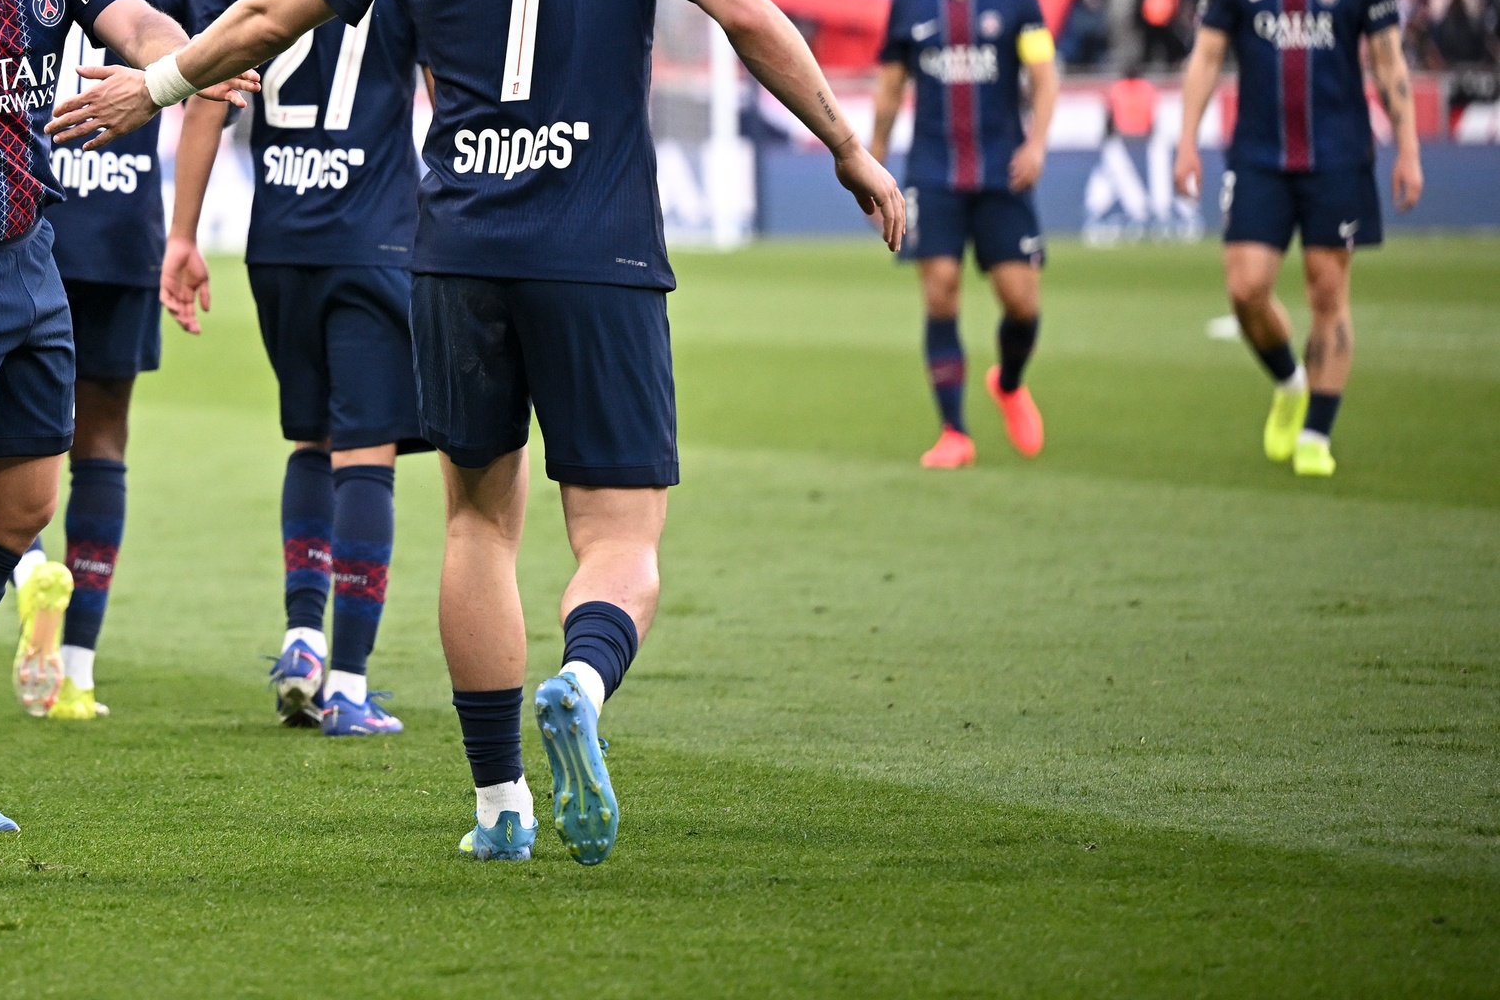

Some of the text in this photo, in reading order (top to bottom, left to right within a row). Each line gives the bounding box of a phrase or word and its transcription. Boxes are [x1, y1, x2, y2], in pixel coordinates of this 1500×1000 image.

[51, 147, 138, 197] nipes
[263, 145, 350, 195] snipes
[453, 121, 574, 181] snipes
